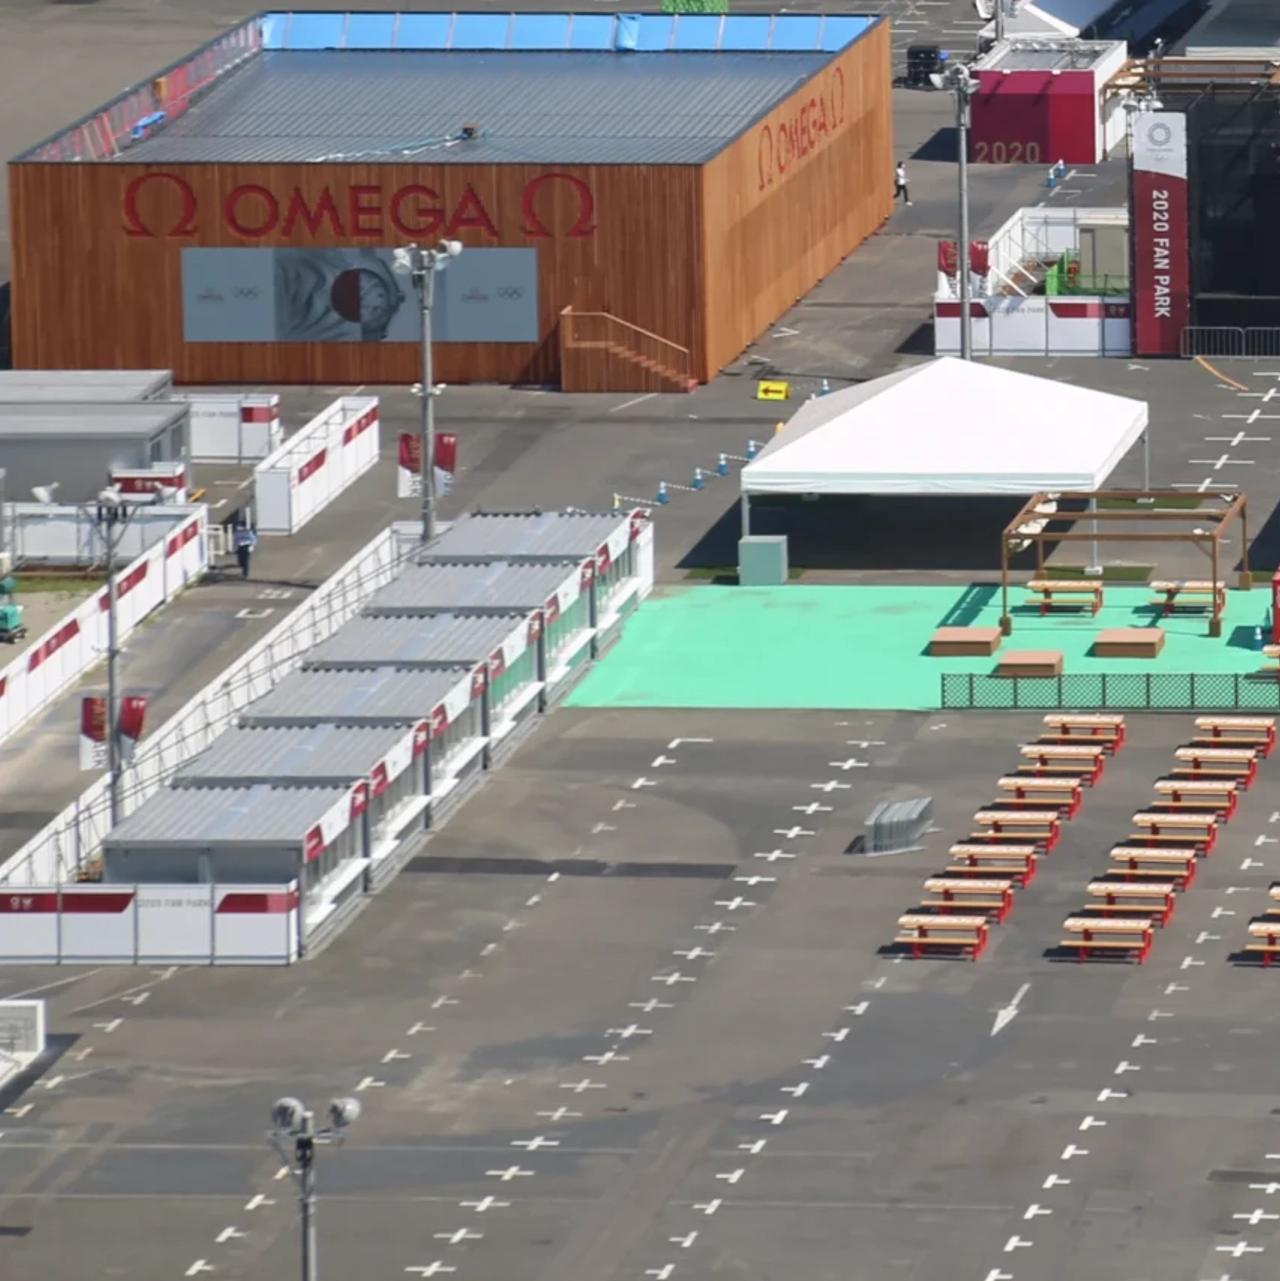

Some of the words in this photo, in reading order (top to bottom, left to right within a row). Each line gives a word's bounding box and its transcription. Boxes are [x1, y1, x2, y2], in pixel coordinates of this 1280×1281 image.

[975, 141, 1041, 164] 2020
[222, 183, 499, 238] OMEGA
[1152, 189, 1169, 232] 2020
[1153, 238, 1170, 270] FAN
[1154, 275, 1171, 318] PARK
